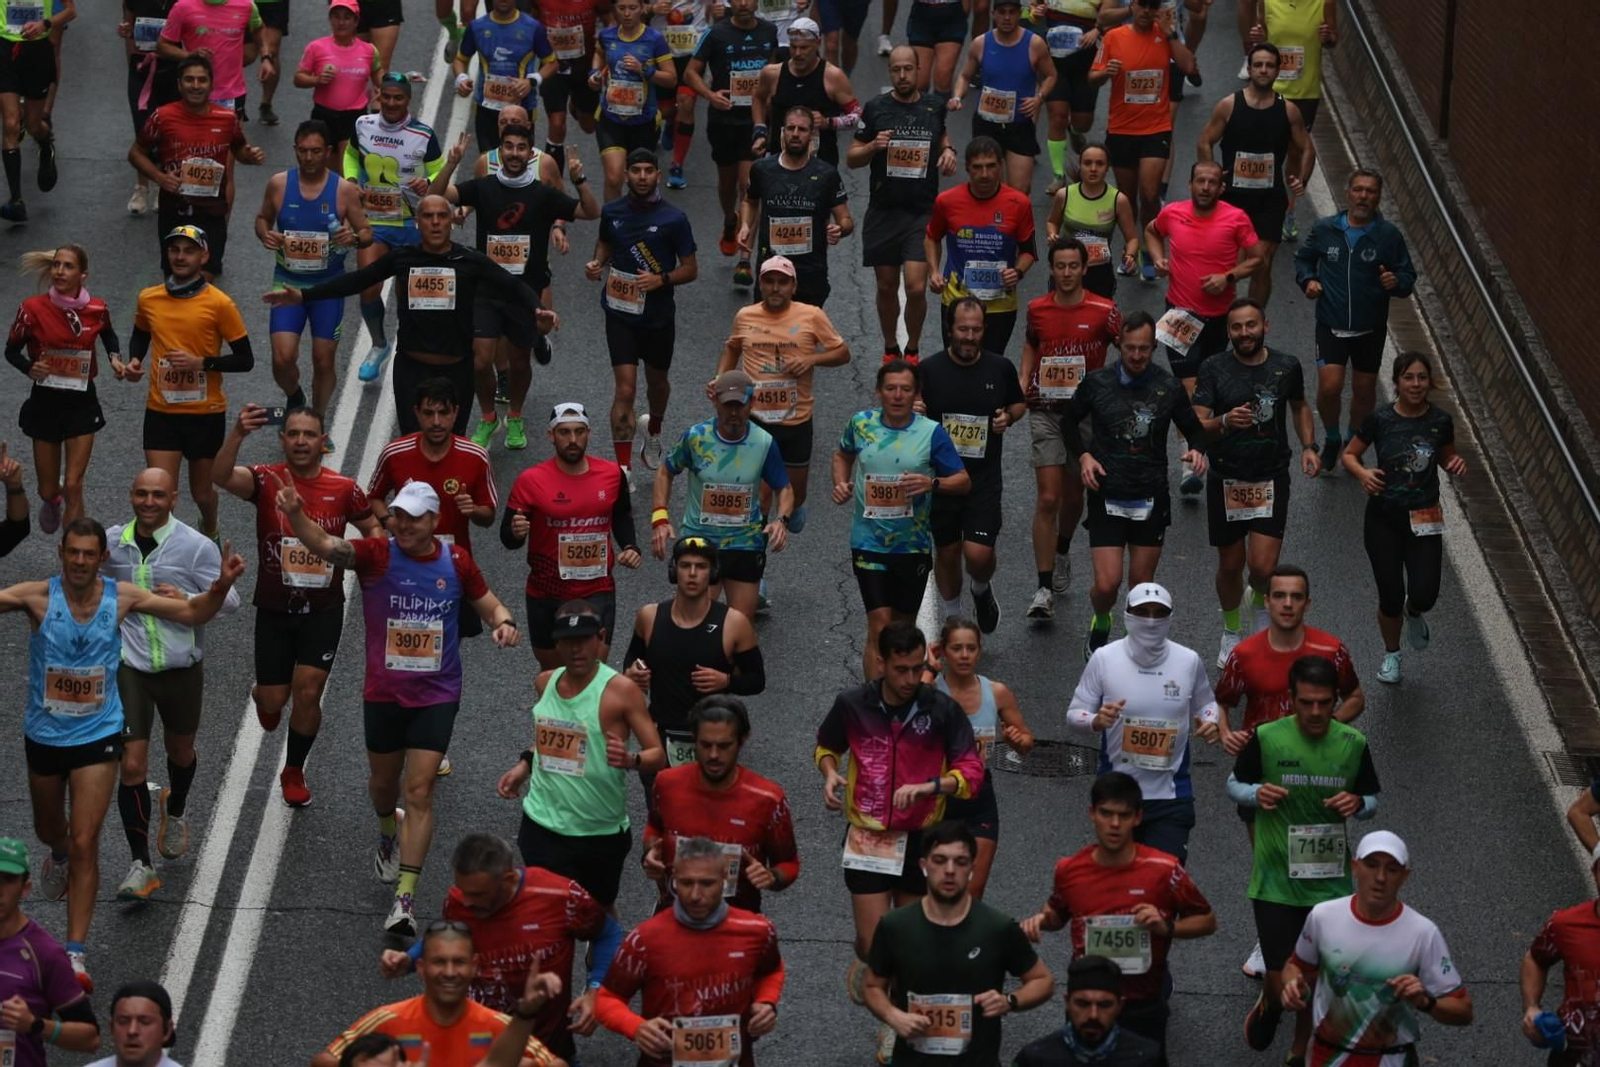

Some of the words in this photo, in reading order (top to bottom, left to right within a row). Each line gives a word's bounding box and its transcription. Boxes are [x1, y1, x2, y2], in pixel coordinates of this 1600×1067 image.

[489, 83, 512, 97] 4882
[1131, 78, 1155, 90] 5723
[985, 97, 1007, 109] 4750
[370, 134, 404, 146] FONTANA
[894, 150, 921, 162] 4245
[187, 166, 214, 181] 4023
[1240, 162, 1265, 175] 6130
[368, 194, 393, 207] 4856
[776, 226, 803, 238] 4244
[957, 229, 975, 239] 45
[290, 241, 318, 255] 5426
[492, 245, 521, 258] 4633
[971, 270, 999, 284] 3280
[414, 278, 445, 292] 4455
[611, 279, 636, 296] 4961
[164, 370, 196, 384] 4978
[1045, 367, 1075, 381] 4715
[757, 391, 788, 403] 4518
[946, 424, 982, 439] 14737
[871, 485, 899, 500] 3987
[1231, 487, 1263, 502] 3555
[710, 494, 743, 509] 3985
[546, 517, 568, 529] Los
[289, 549, 322, 568] 6364
[567, 543, 599, 560] 5262
[390, 594, 453, 614] FILÍPIDES
[395, 632, 430, 649] 3907
[54, 677, 92, 696] 4909
[539, 729, 575, 751] 3737
[1130, 730, 1167, 748] 5807
[1281, 773, 1309, 785] MEDIO
[1298, 837, 1335, 855] 7154
[1094, 930, 1135, 949] 7456
[684, 1033, 725, 1052] 5061
